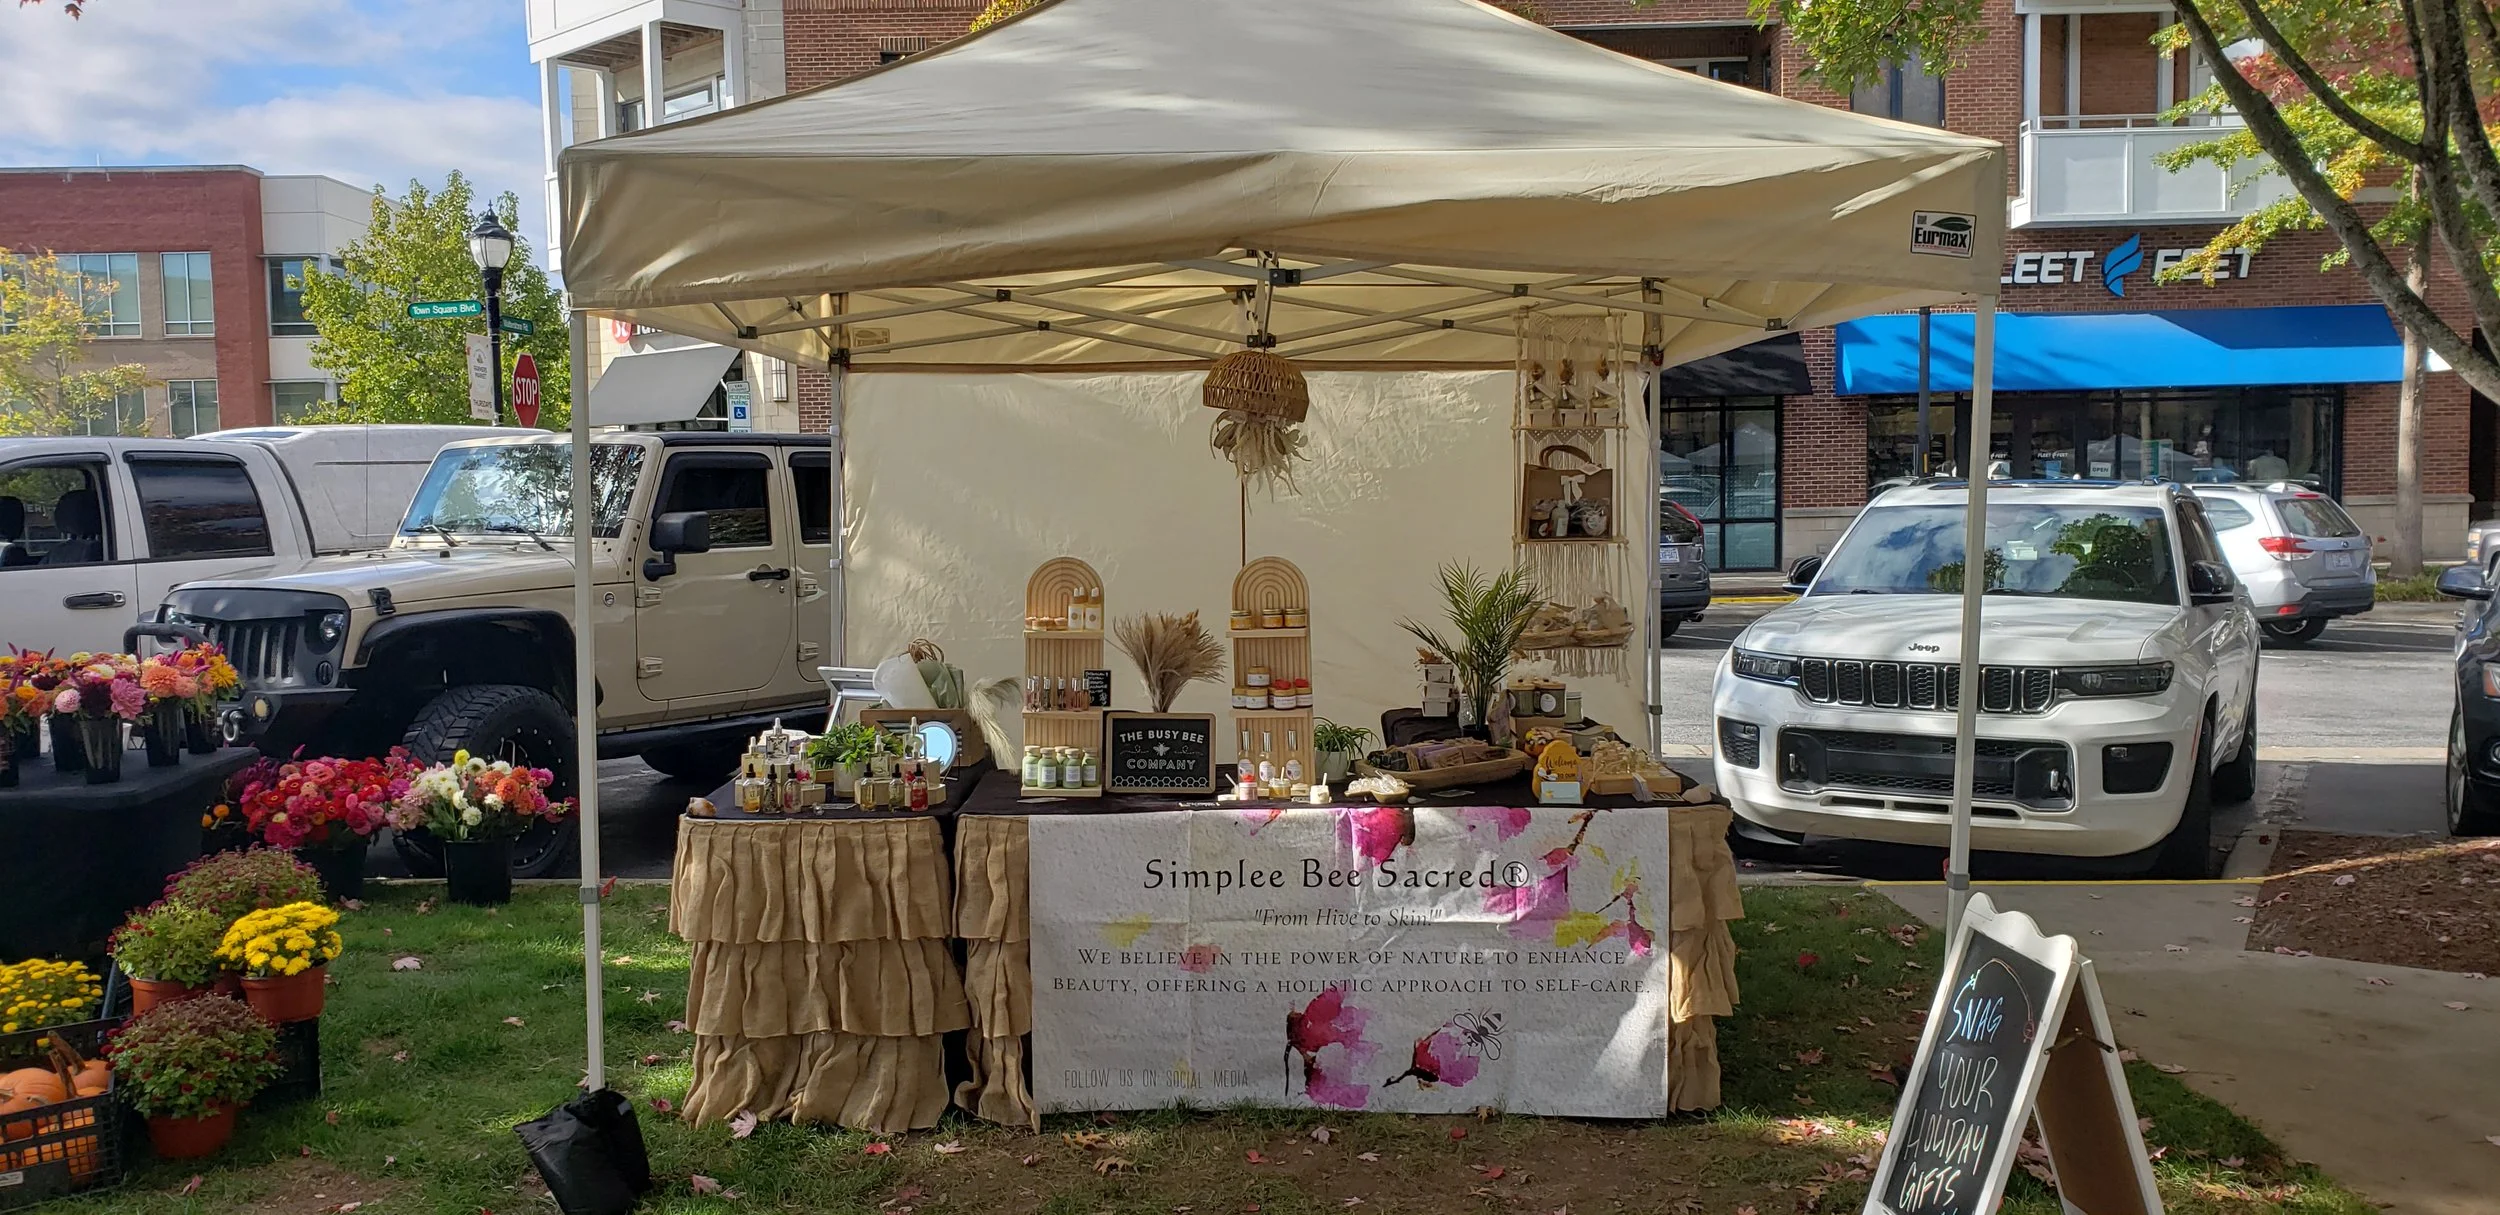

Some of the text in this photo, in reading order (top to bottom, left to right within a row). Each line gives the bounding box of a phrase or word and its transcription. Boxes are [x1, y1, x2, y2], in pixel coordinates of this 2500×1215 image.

[1915, 227, 1968, 248] Eurmax
[413, 304, 477, 315] Town Square Blvd.
[515, 377, 538, 405] STOP
[1908, 643, 1940, 653] Jeep
[1120, 729, 1205, 744] THE BUSY BEE
[1126, 758, 1196, 770] COMPANY
[1545, 756, 1577, 769] Welcome
[1143, 858, 1285, 895] Simplee
[1301, 858, 1361, 888] Bee
[1316, 908, 1357, 926] Hive
[1364, 912, 1381, 926] to
[1078, 948, 1625, 965] WE BELIEVE IN THE POWER OF NATURE TO ENHANCE
[1053, 977, 1651, 993] BEAUTY, OFFERING A HOLISTIC APPROACH TO SELF-CARE.
[1946, 978, 2004, 1043] SNAG
[1064, 1068, 1248, 1089] FOLLOW US ON SOCIAL MEDIA
[1938, 1051, 1999, 1113] YOUR
[1904, 1109, 1988, 1176] HOLIDAY
[1899, 1161, 1962, 1213] GIFTS
